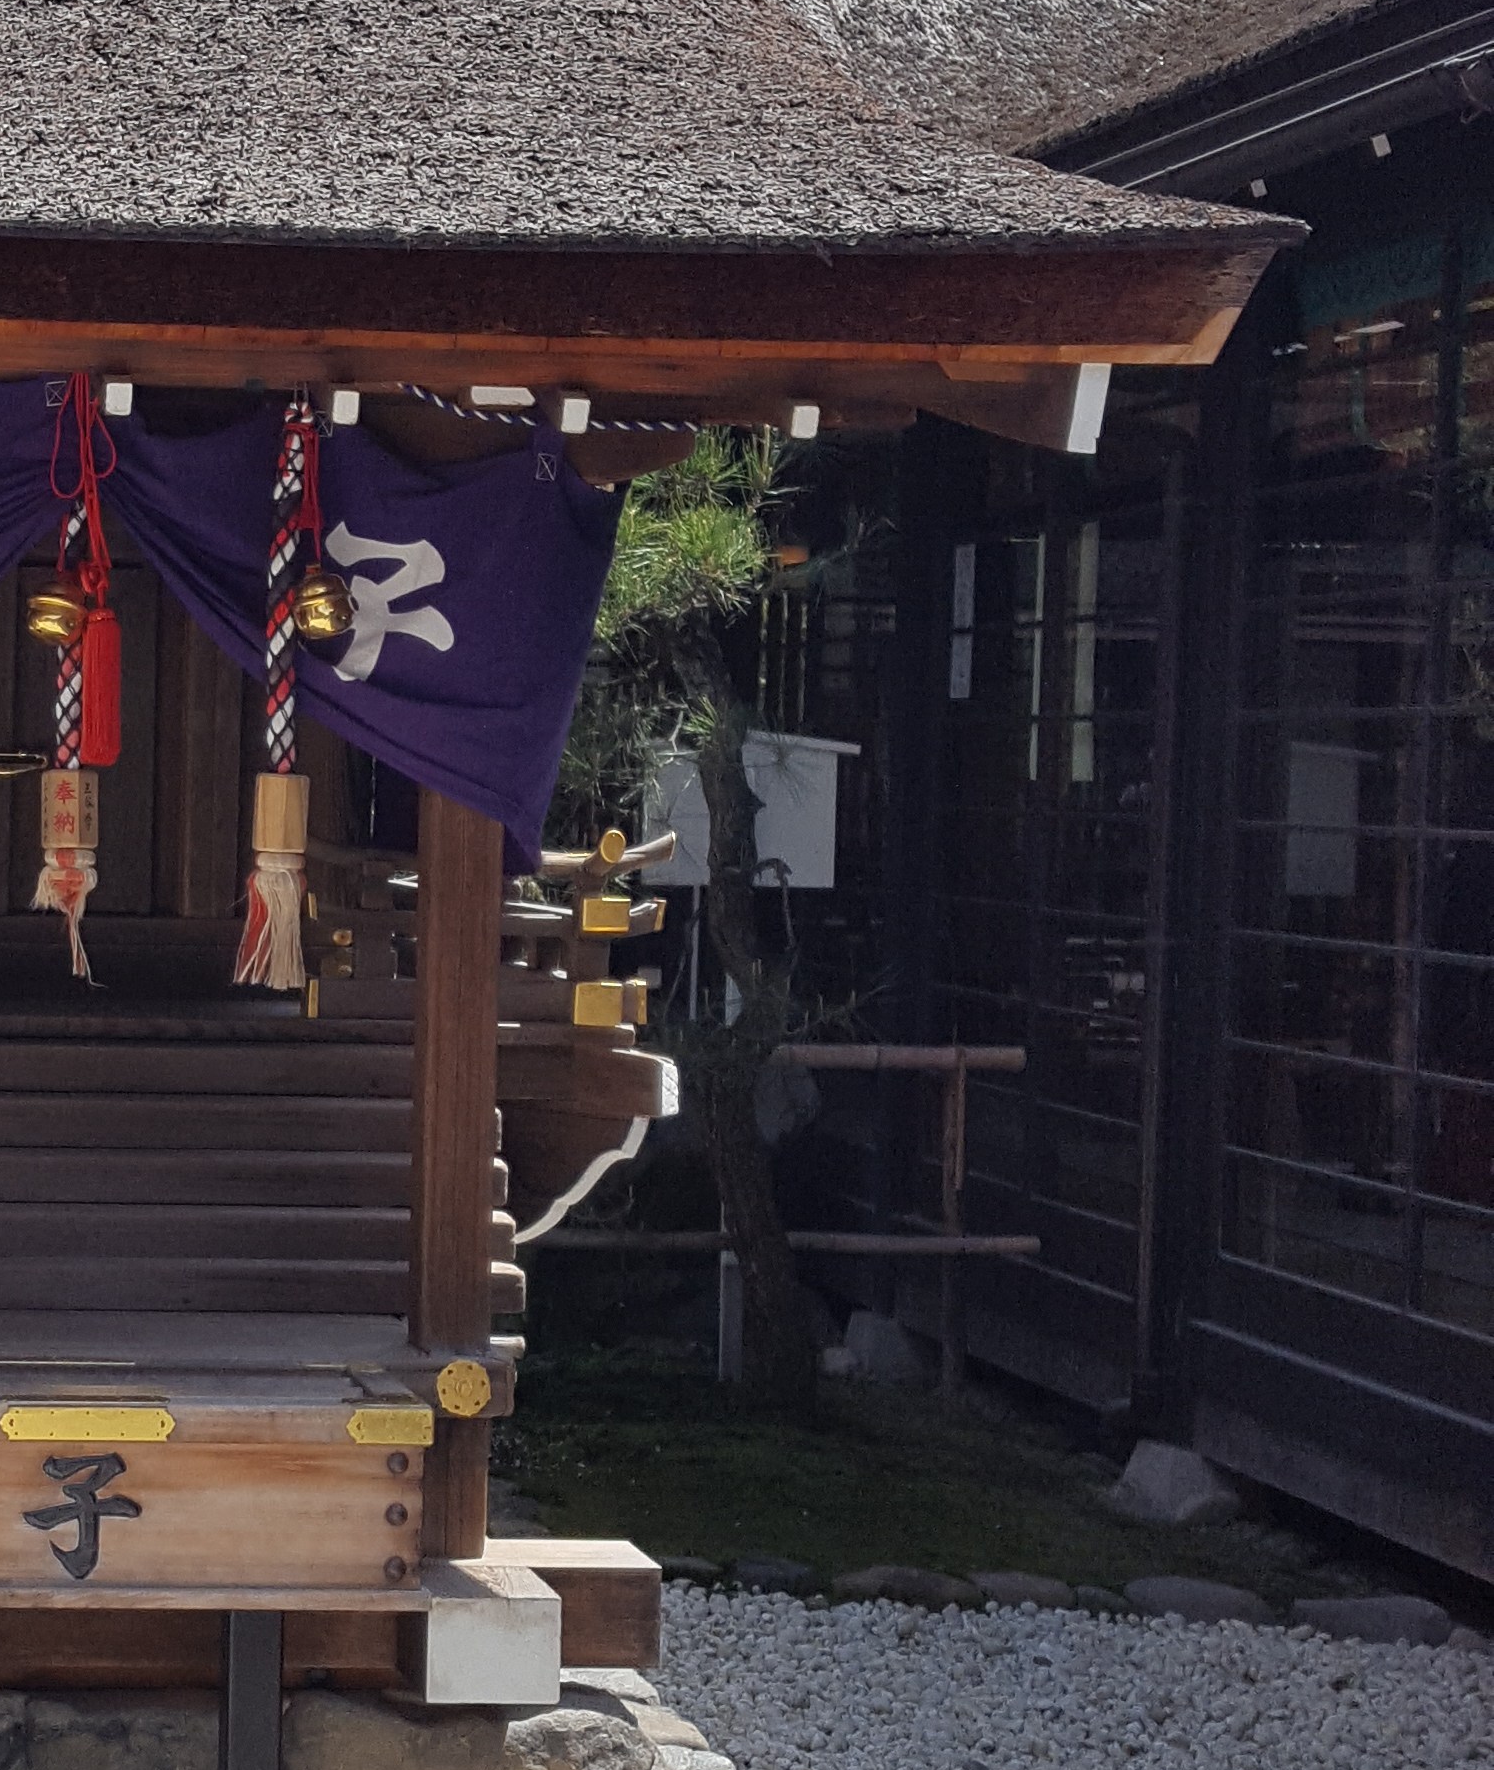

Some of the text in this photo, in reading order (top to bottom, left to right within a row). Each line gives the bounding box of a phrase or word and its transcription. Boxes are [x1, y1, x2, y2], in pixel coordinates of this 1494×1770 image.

[326, 521, 455, 682] 子
[53, 779, 77, 835] 奉納
[22, 1452, 143, 1581] 子
